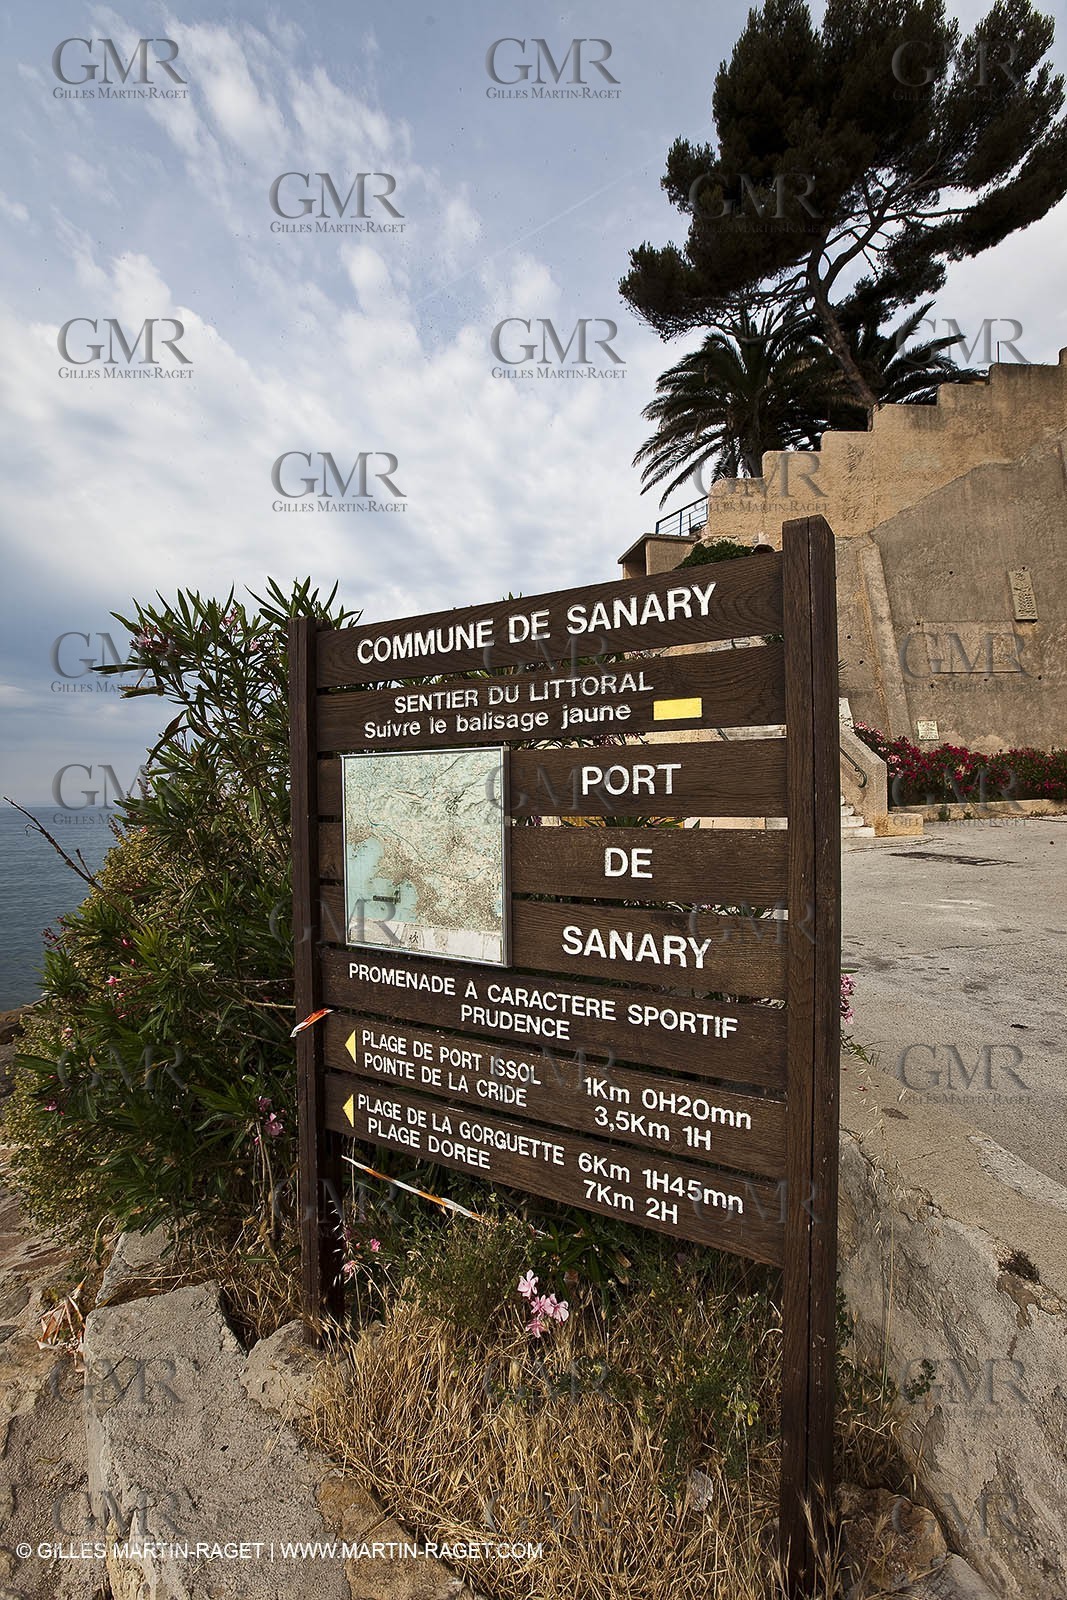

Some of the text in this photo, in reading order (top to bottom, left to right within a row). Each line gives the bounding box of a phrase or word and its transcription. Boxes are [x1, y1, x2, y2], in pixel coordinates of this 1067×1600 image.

[357, 581, 717, 664] COMMUNE DE SANARY
[364, 704, 632, 739] Suivre le balisage jaune
[394, 671, 654, 714] SENTIER DU LITTORAL
[581, 763, 682, 796] PORT
[604, 847, 653, 879] DE
[561, 925, 712, 969] SANARY
[349, 962, 738, 1039] PROMENADE A CARACTERE SPORTIF
[460, 1003, 571, 1041] PRUDENCE
[362, 1029, 752, 1130] PLAGE DE PORT ISSOL 1Km 0H20mn
[364, 1052, 712, 1151] POINTE DE LA CRIDE 3,5Km 1H
[357, 1093, 744, 1214] PLAGE DE LA GORGUETTE 6Km 1H45mn
[367, 1116, 678, 1225] PLAGE DOREE 7Km 2H
